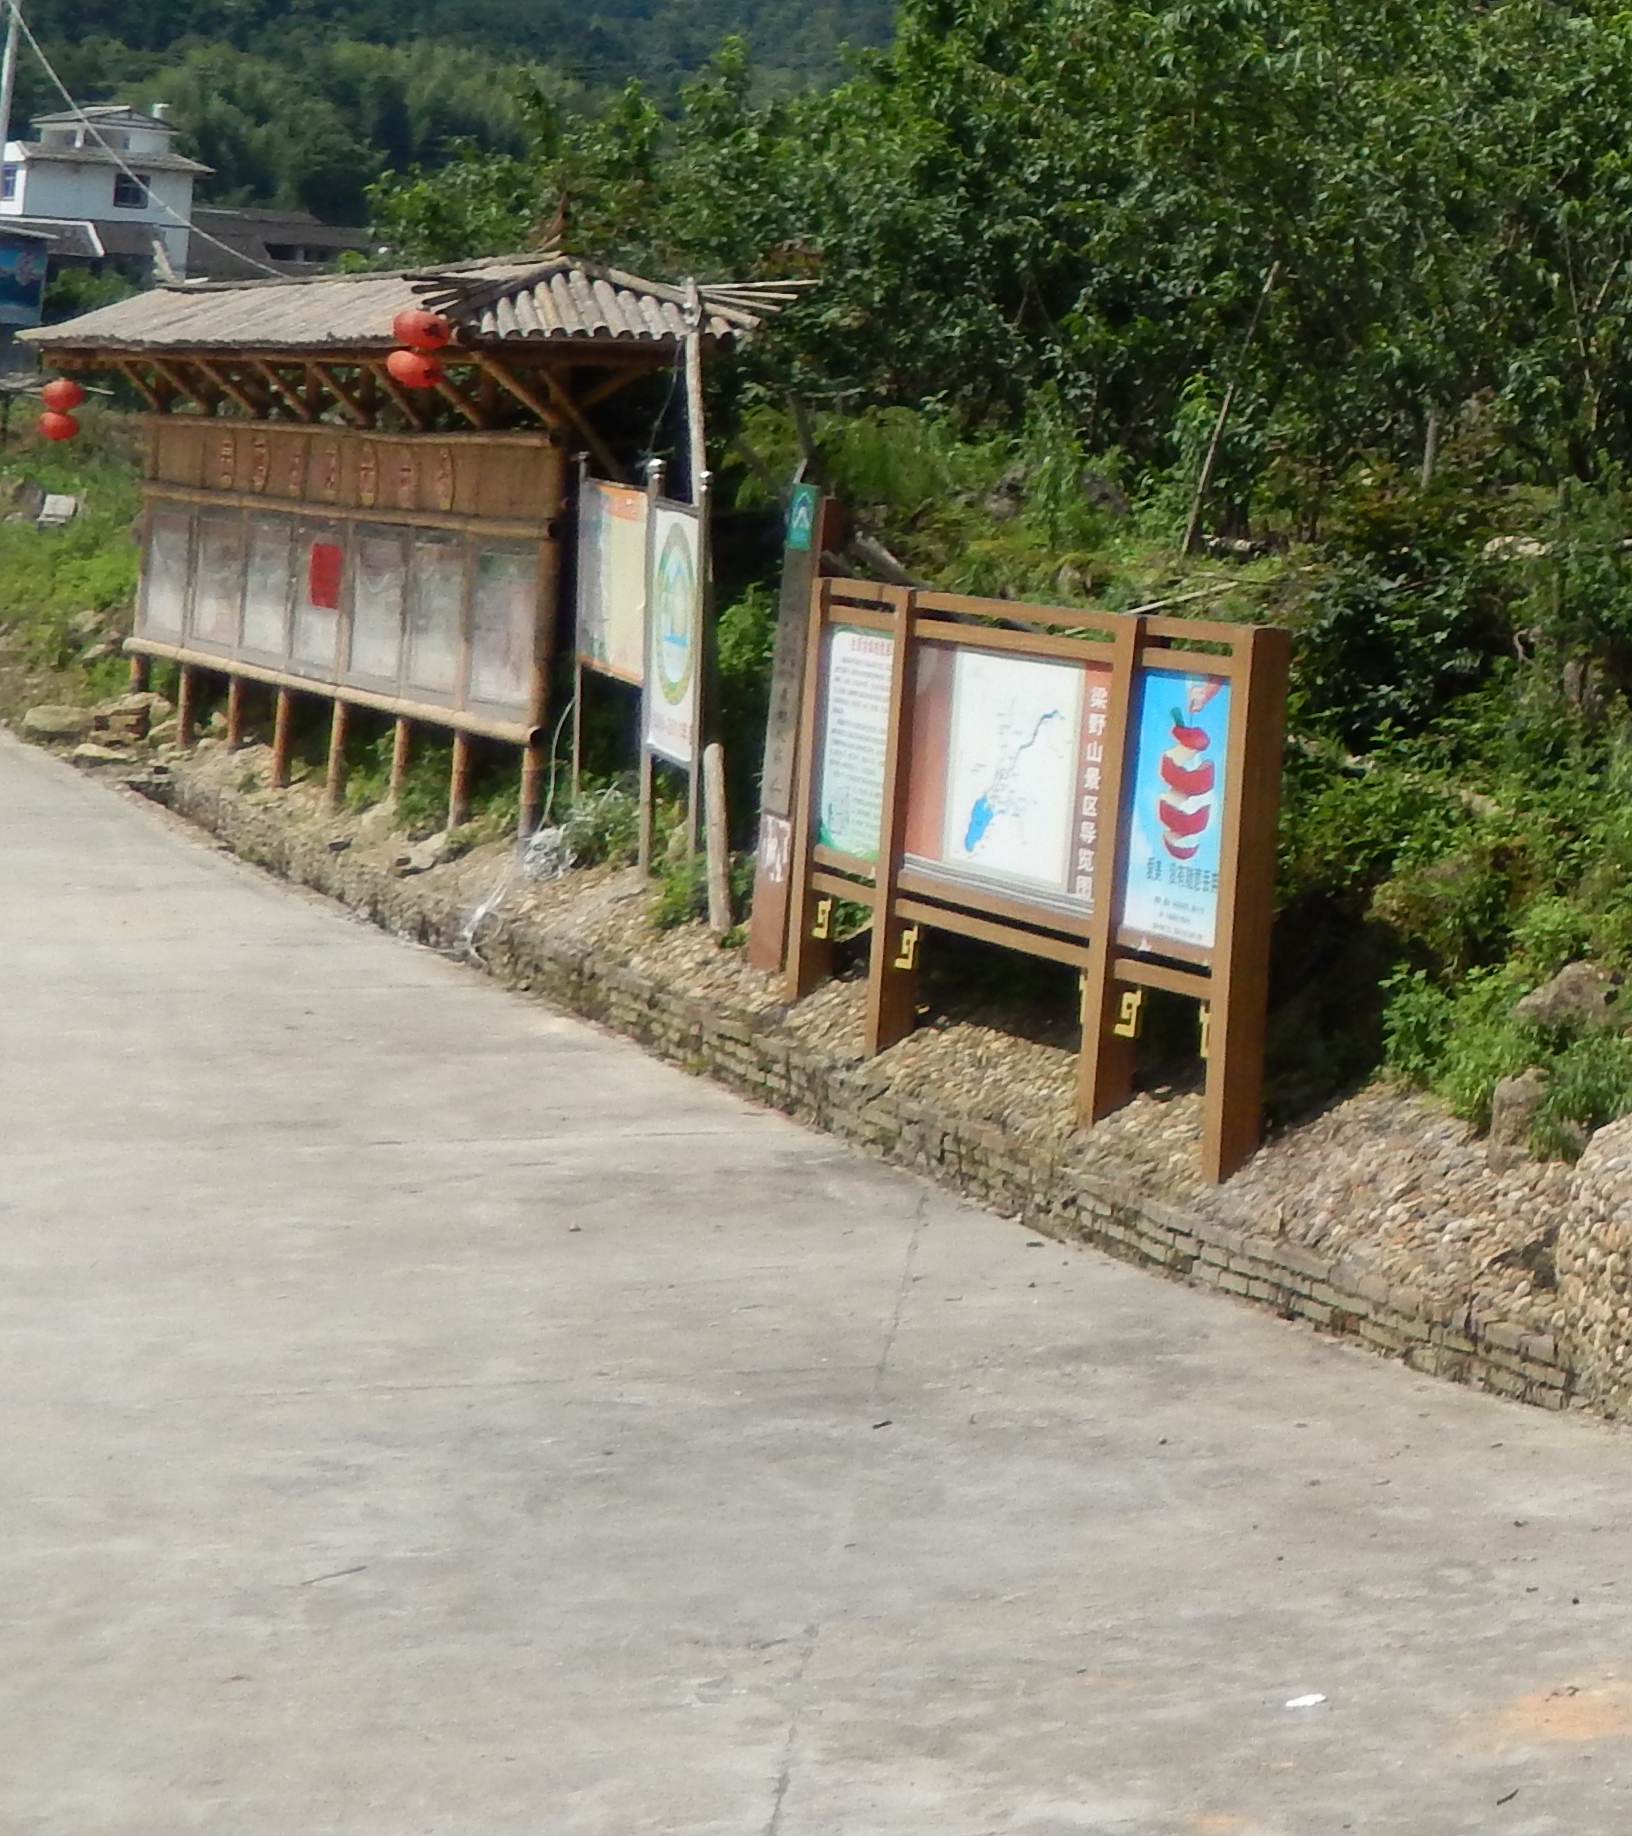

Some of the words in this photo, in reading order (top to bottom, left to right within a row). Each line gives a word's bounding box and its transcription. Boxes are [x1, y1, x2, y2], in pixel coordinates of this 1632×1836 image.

[1074, 686, 1109, 901] 梁野山景区导览图
